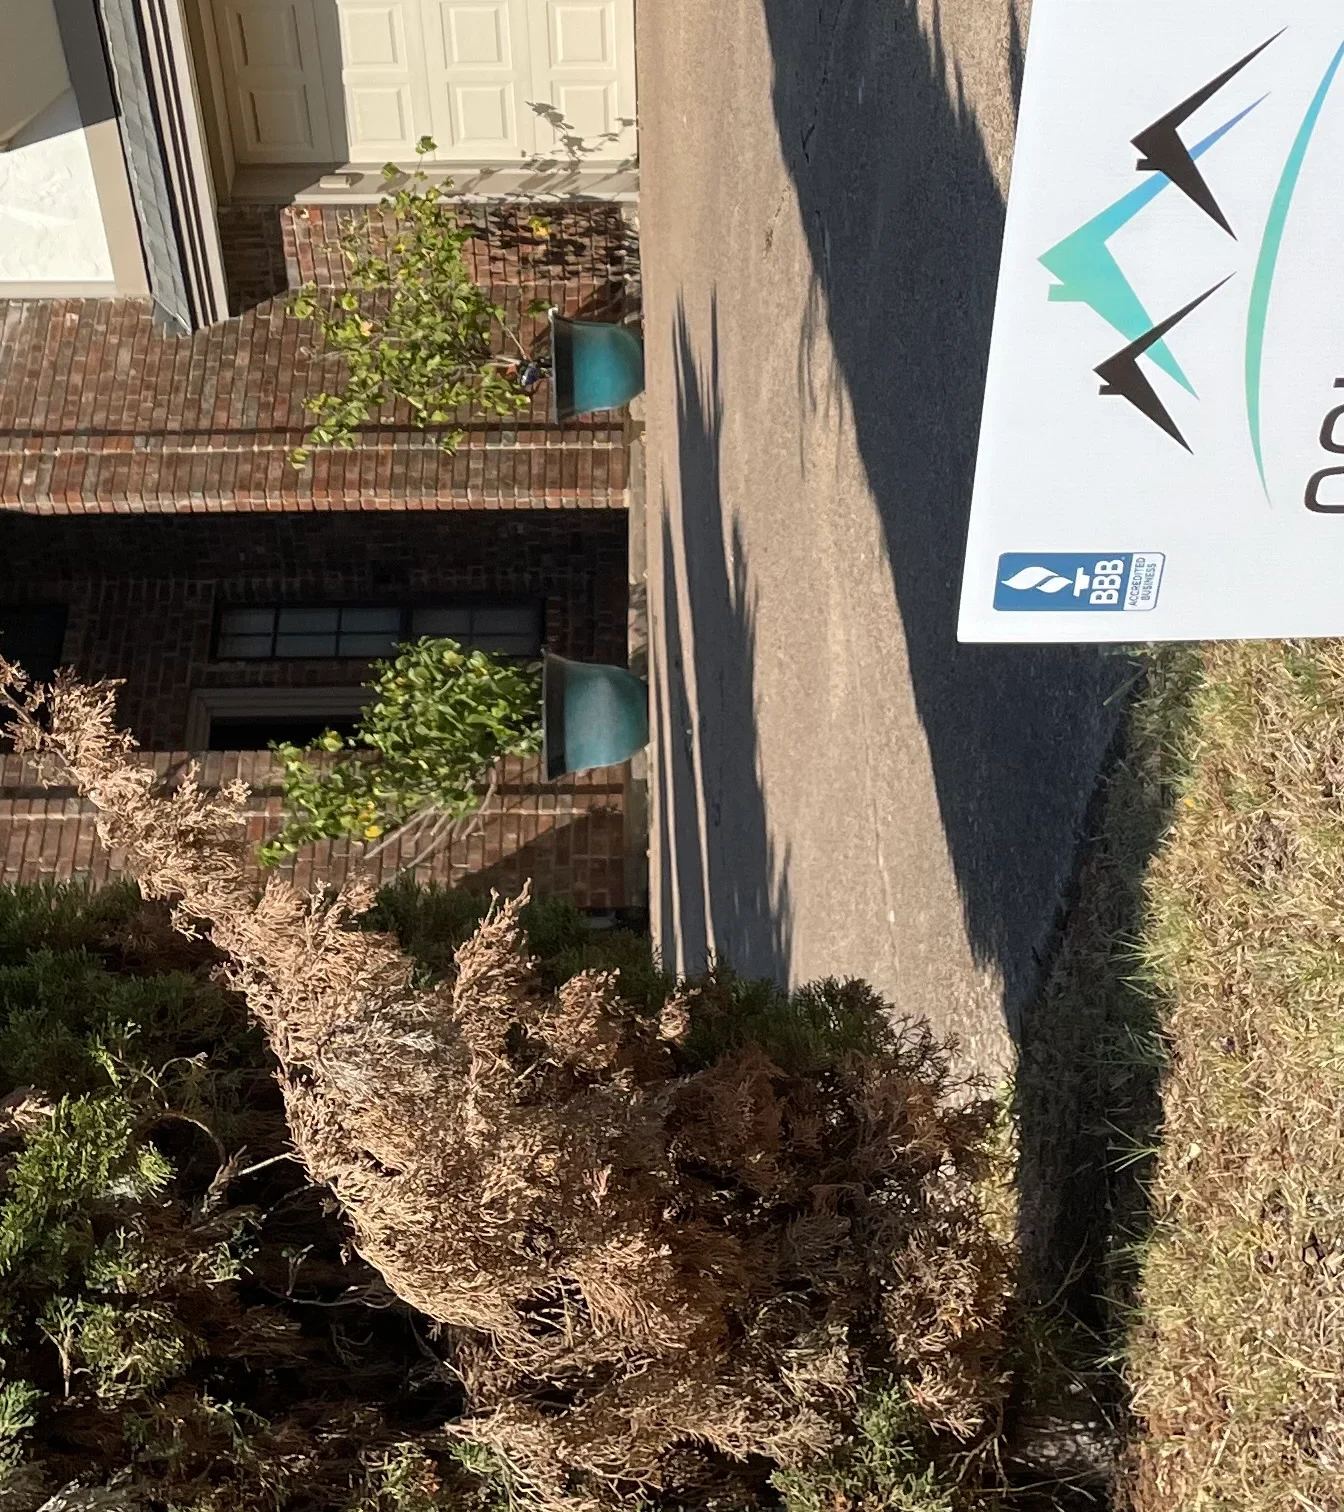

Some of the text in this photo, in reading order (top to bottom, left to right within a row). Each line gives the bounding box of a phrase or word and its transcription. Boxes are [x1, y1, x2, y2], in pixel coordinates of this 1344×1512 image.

[1089, 559, 1124, 604] BBB
[1128, 557, 1146, 606] ACCREDITED
[1140, 563, 1156, 600] BUSINESS
